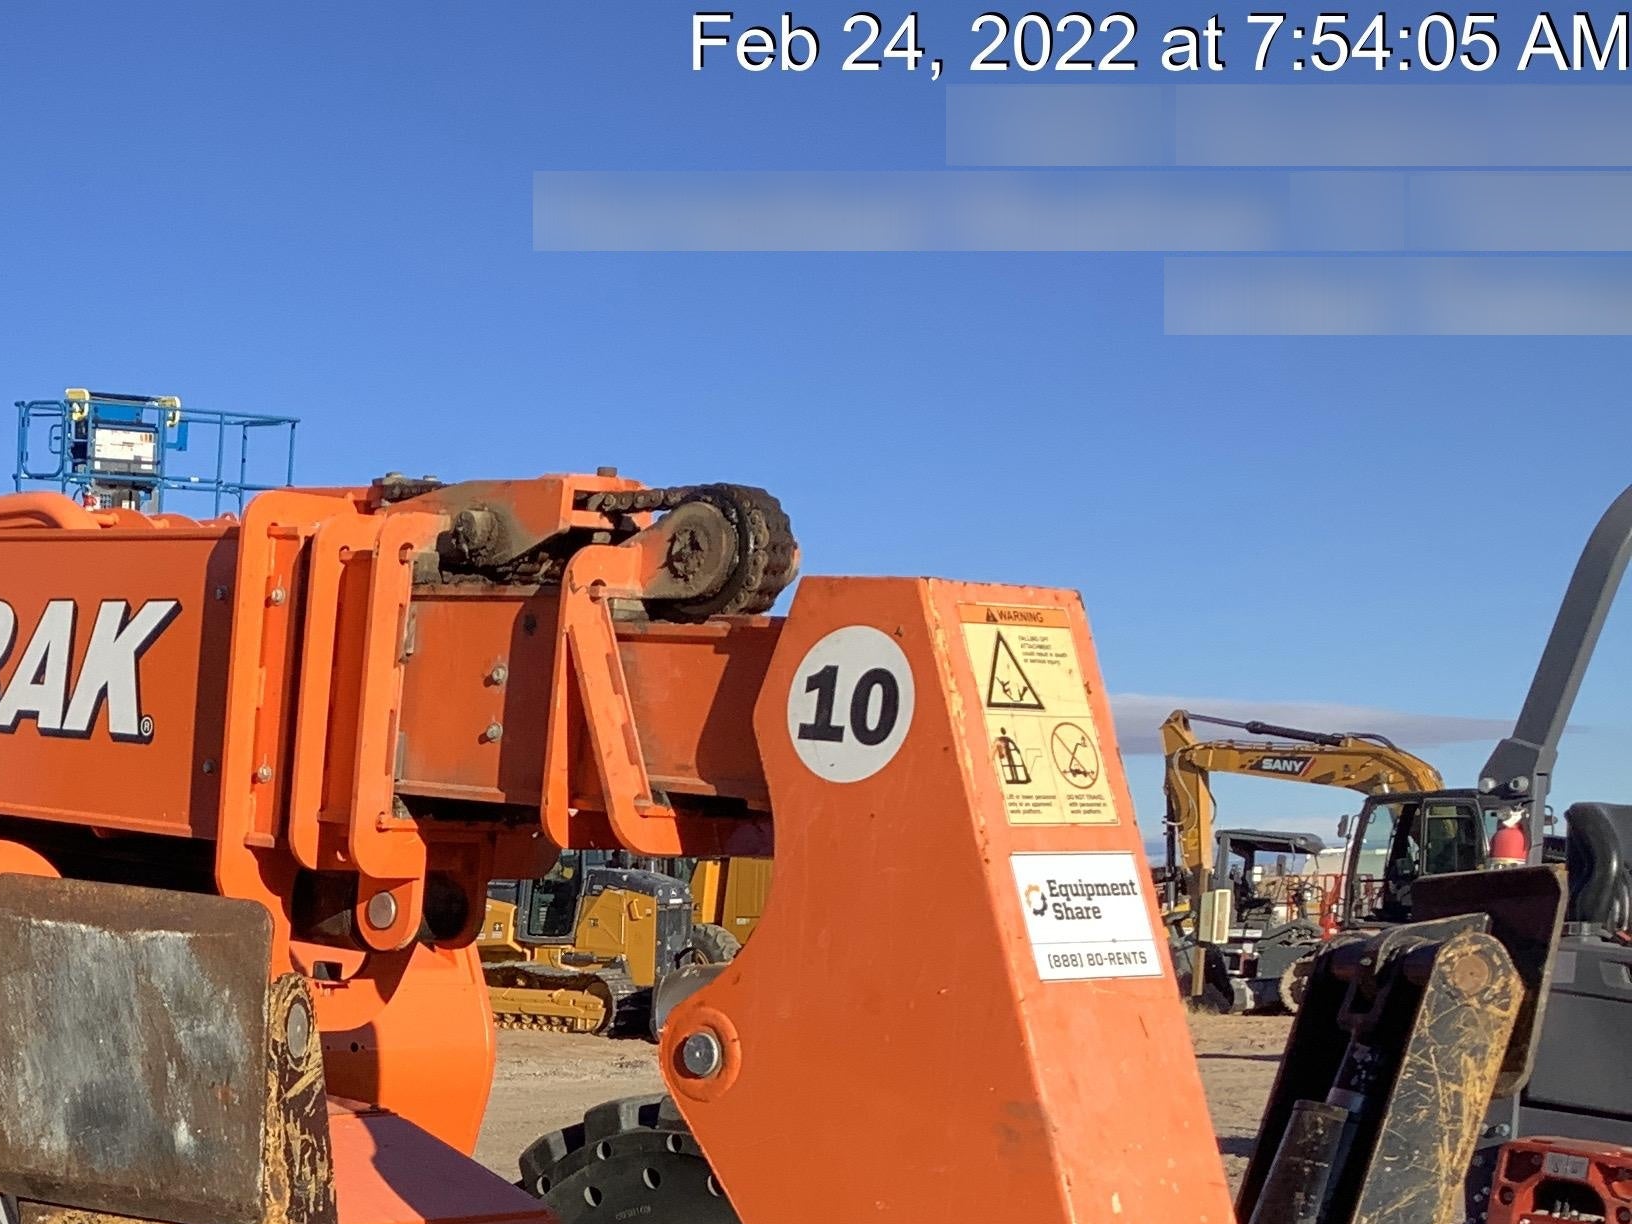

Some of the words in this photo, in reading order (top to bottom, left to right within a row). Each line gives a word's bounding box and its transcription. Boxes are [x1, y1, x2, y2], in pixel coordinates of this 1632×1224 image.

[997, 609, 1044, 624] WARNING
[797, 665, 900, 746] 10
[1261, 758, 1304, 772] SANY
[1046, 879, 1138, 901] Equipment
[1052, 902, 1103, 921] Share
[1087, 951, 1148, 966] 80-RENTS
